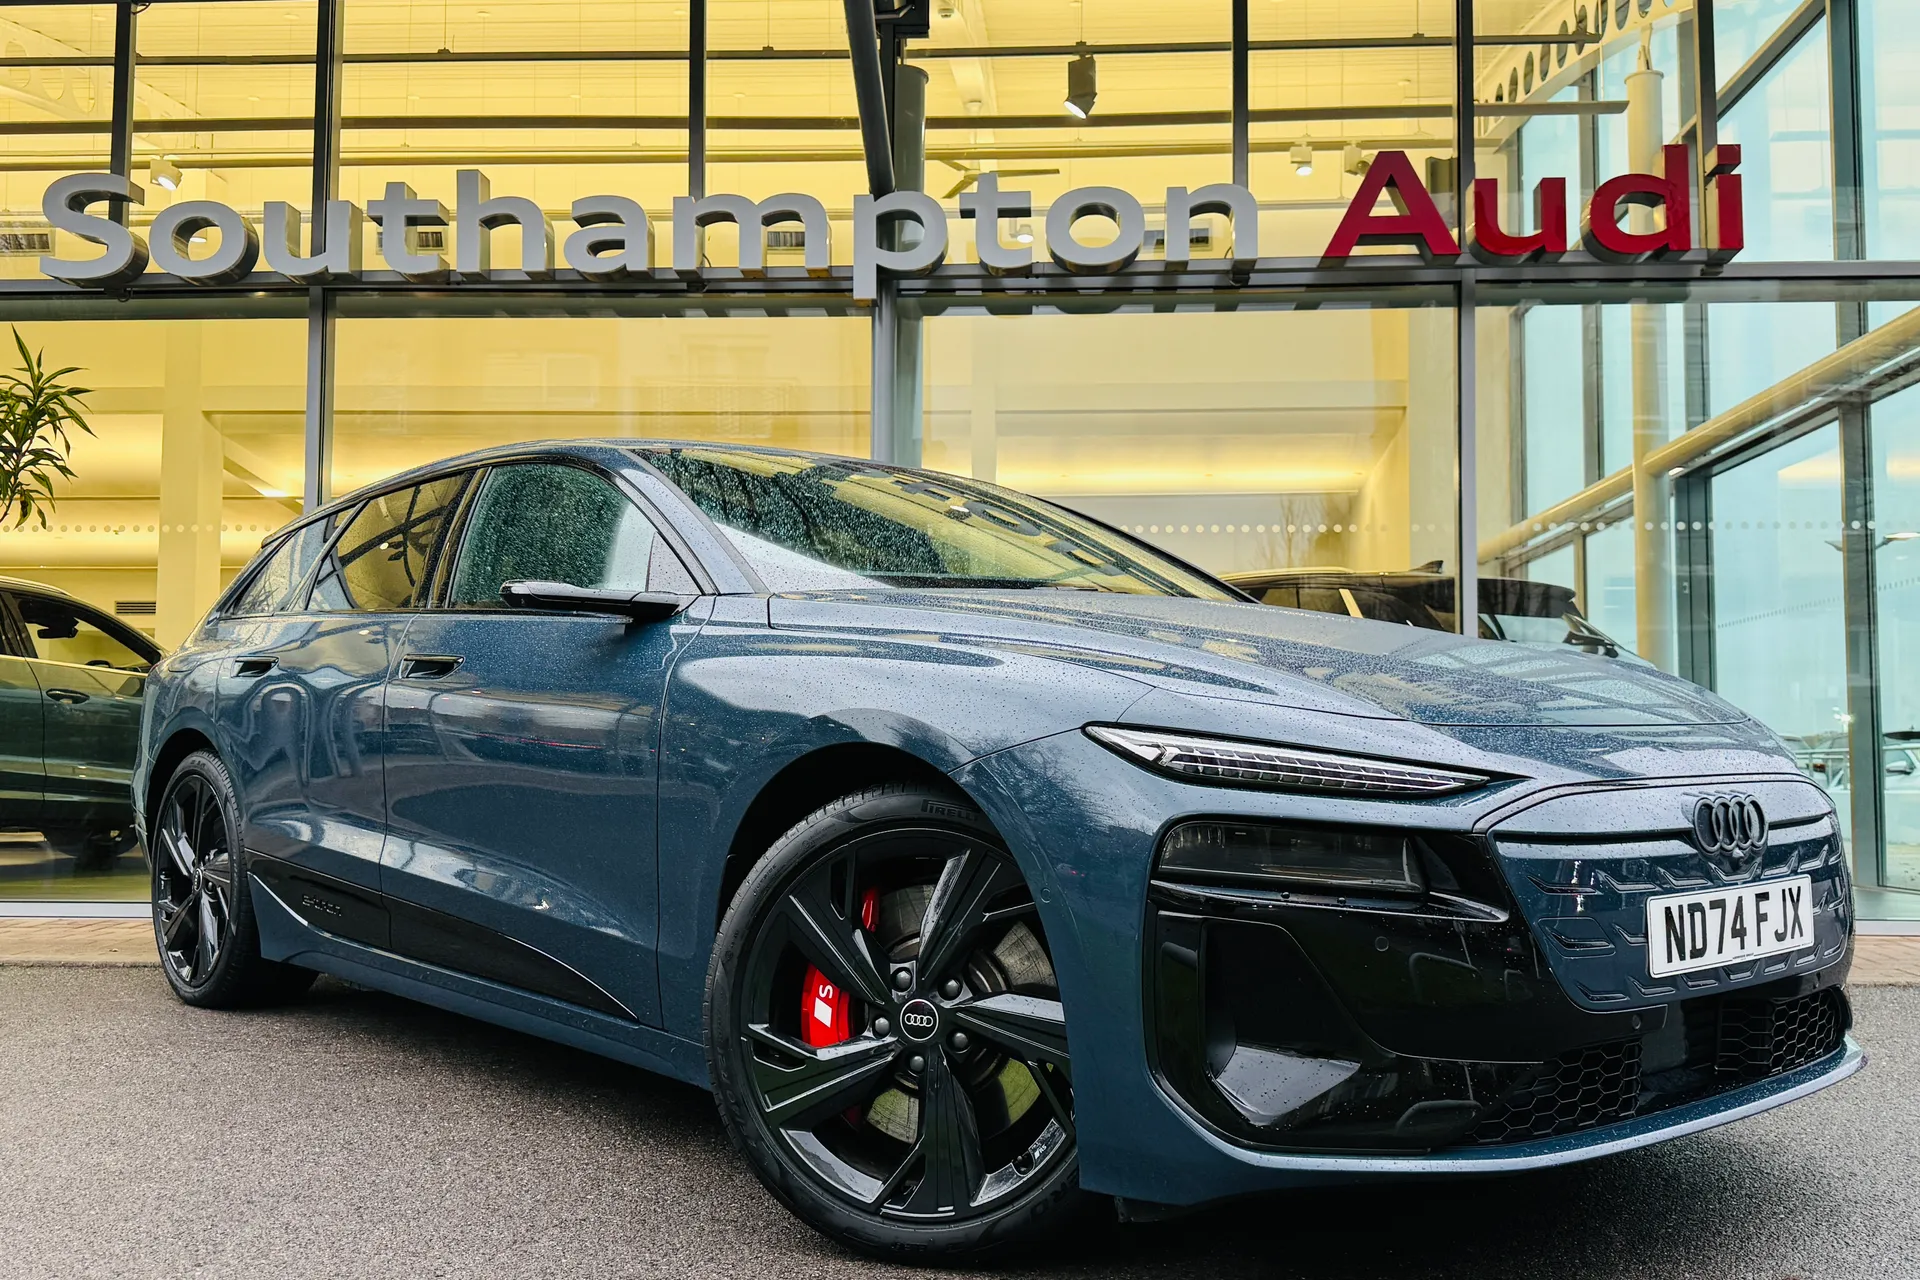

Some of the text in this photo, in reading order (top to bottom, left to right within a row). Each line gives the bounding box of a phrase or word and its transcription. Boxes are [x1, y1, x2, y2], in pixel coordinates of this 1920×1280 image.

[40, 144, 1744, 304] Southampton Audi
[921, 799, 980, 822] PIRELLI
[1664, 886, 1804, 964] ND74 FJX
[818, 984, 834, 999] S
